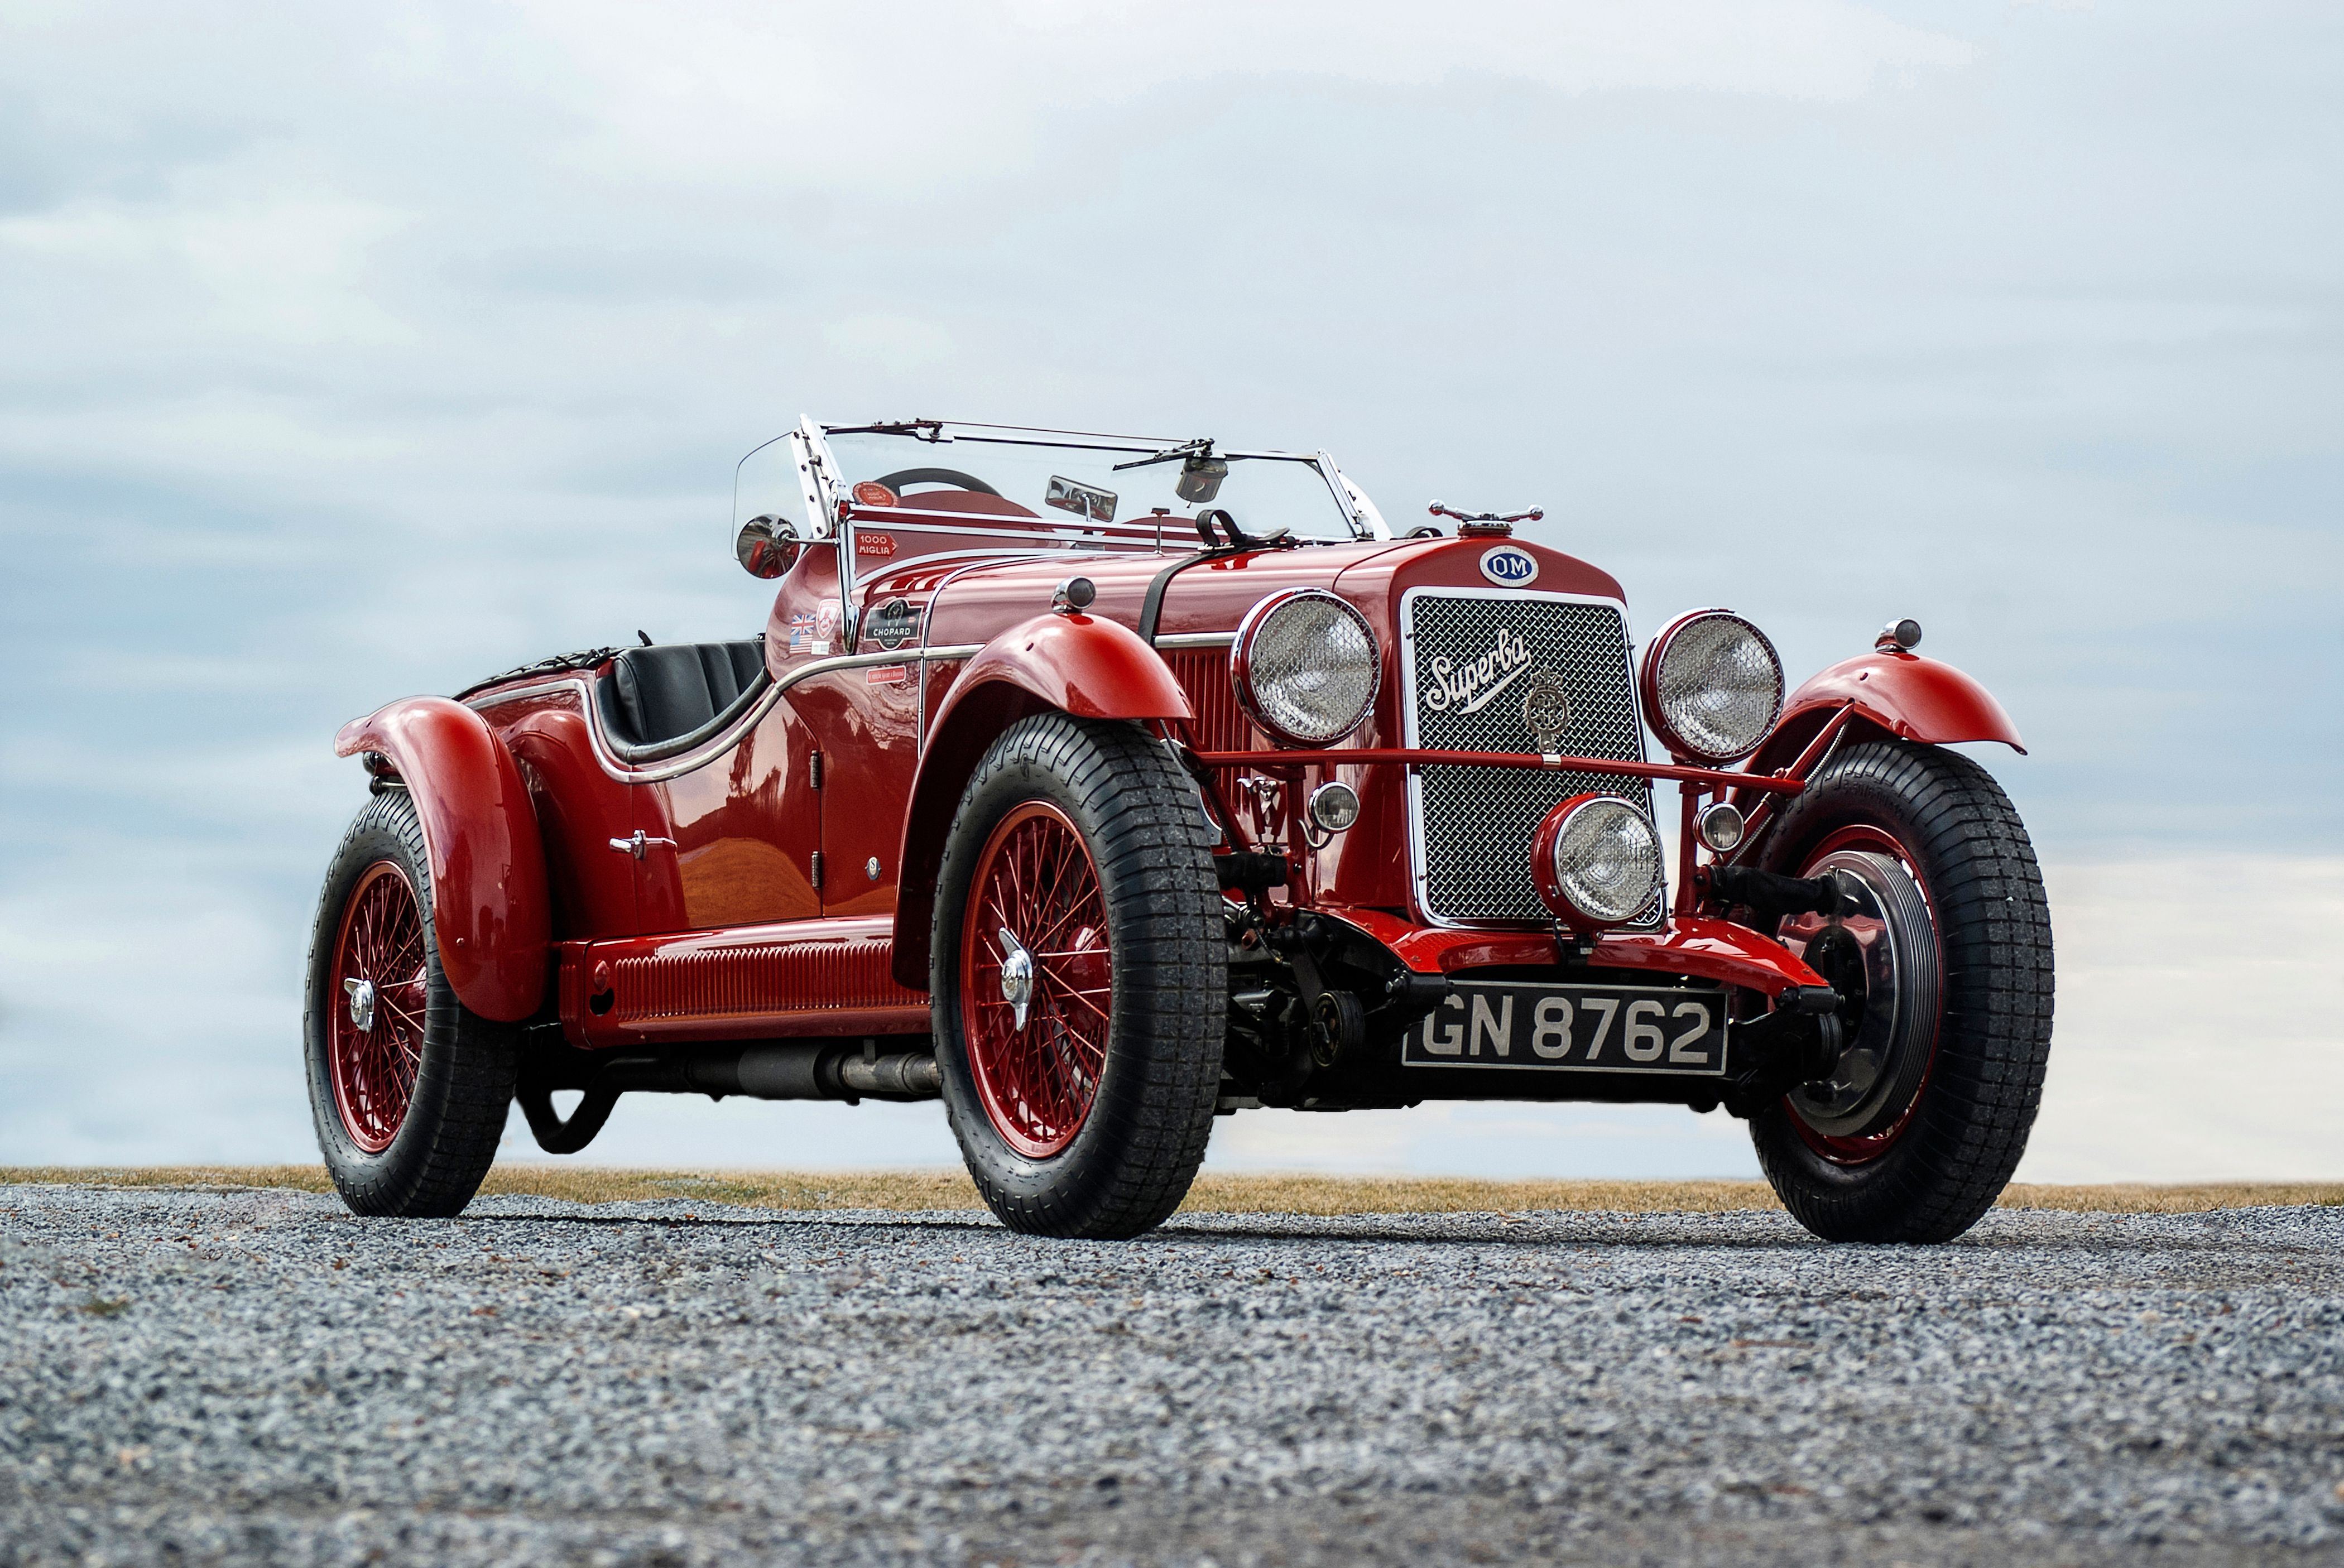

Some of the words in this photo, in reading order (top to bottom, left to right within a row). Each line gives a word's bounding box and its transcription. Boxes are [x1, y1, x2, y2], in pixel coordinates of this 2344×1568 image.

[861, 535, 887, 544] 1000
[859, 546, 890, 555] MIGLIA
[1493, 556, 1528, 576] OM
[873, 628, 911, 636] CHOPARD
[1426, 628, 1531, 715] Superba
[1423, 994, 1513, 1056] GN
[1533, 996, 1711, 1064] 8762
